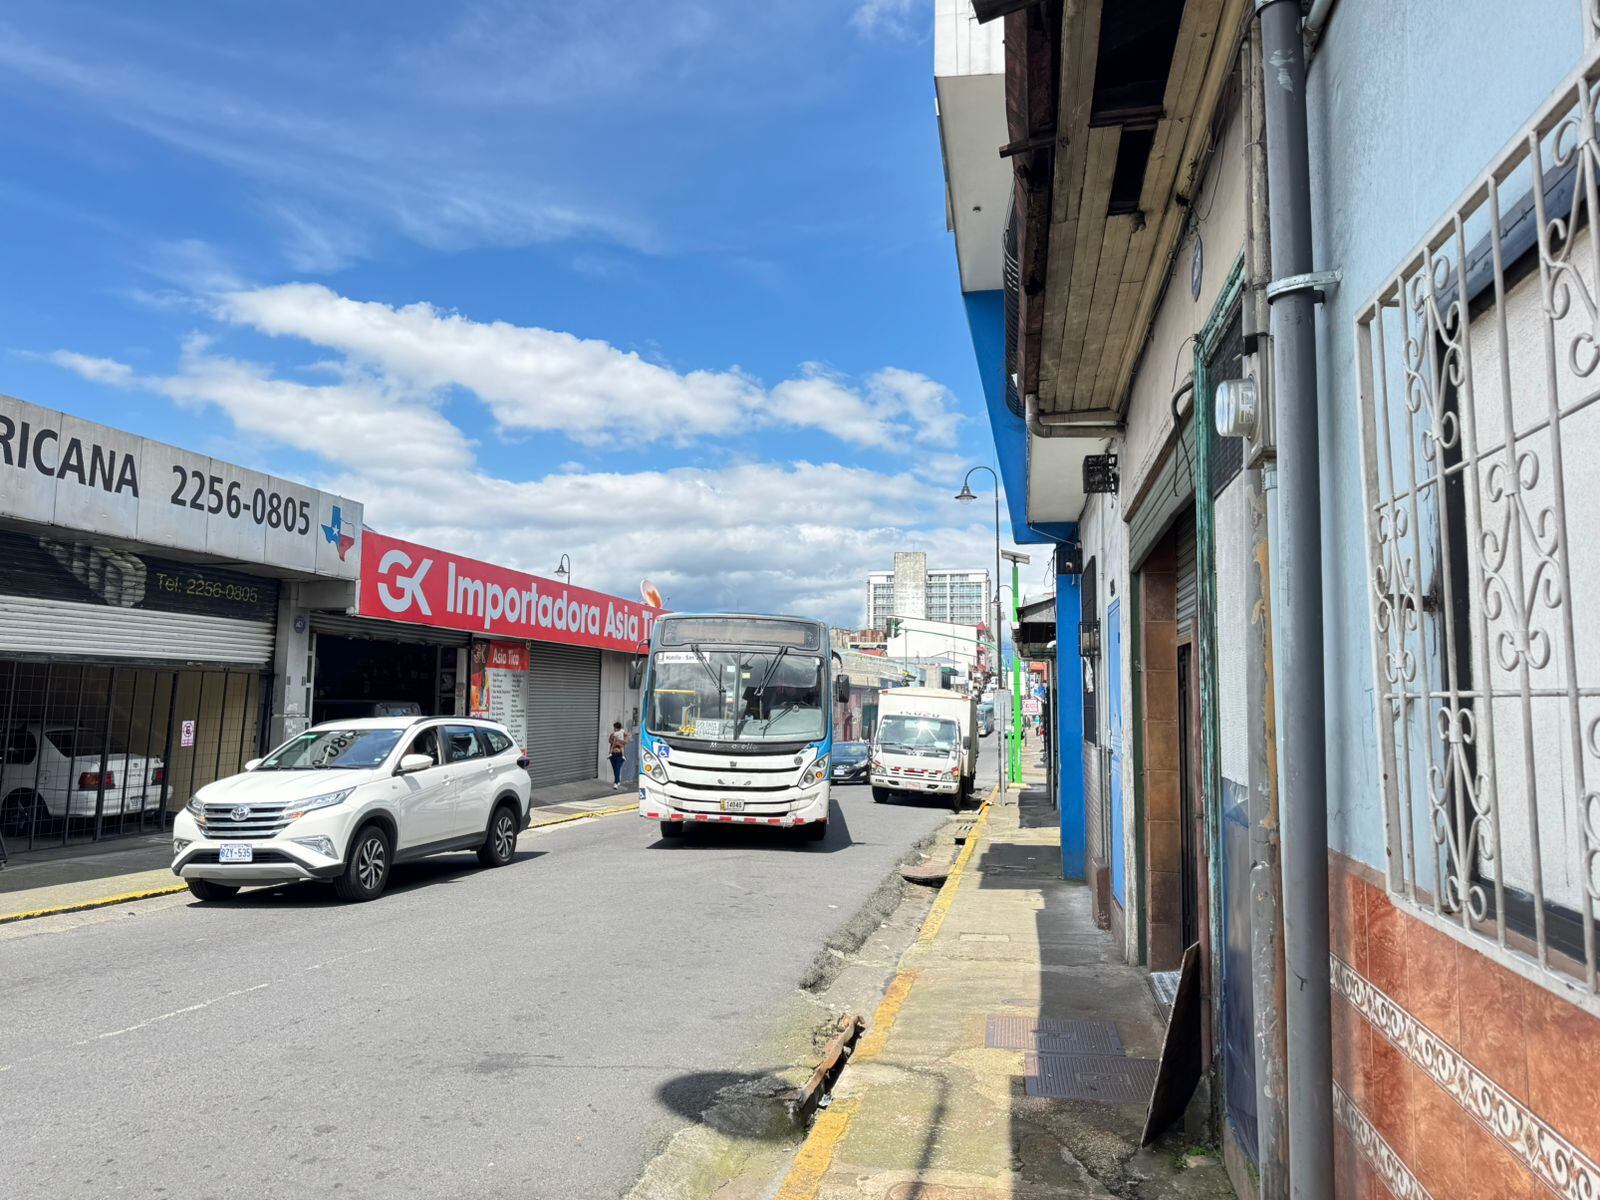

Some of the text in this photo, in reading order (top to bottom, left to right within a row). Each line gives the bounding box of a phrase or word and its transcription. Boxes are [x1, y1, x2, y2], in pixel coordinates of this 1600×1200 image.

[0, 414, 311, 535] RICANA 2256-0805
[156, 573, 258, 602] Tel: 2256-0805
[377, 549, 434, 616] GK
[446, 561, 600, 636] Importadora
[604, 601, 639, 642] Asia
[493, 648, 507, 665] Asia
